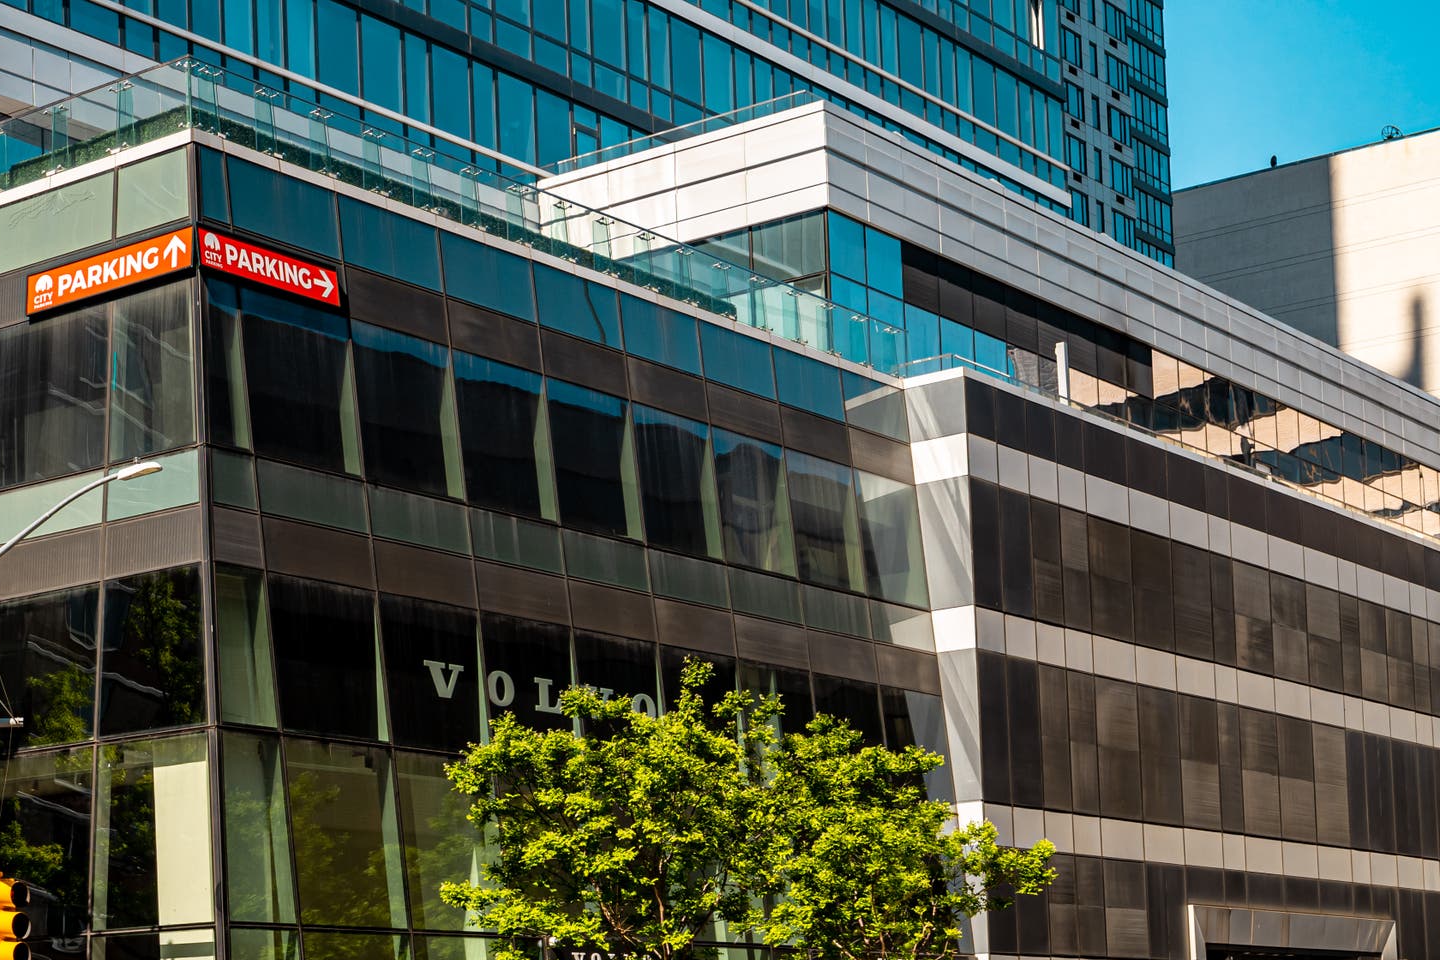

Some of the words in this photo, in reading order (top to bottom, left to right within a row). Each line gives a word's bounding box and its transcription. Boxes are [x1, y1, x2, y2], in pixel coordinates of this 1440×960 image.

[205, 250, 222, 263] CITY
[225, 243, 312, 289] PARKING
[58, 247, 159, 297] PARKING
[33, 291, 53, 304] CITY
